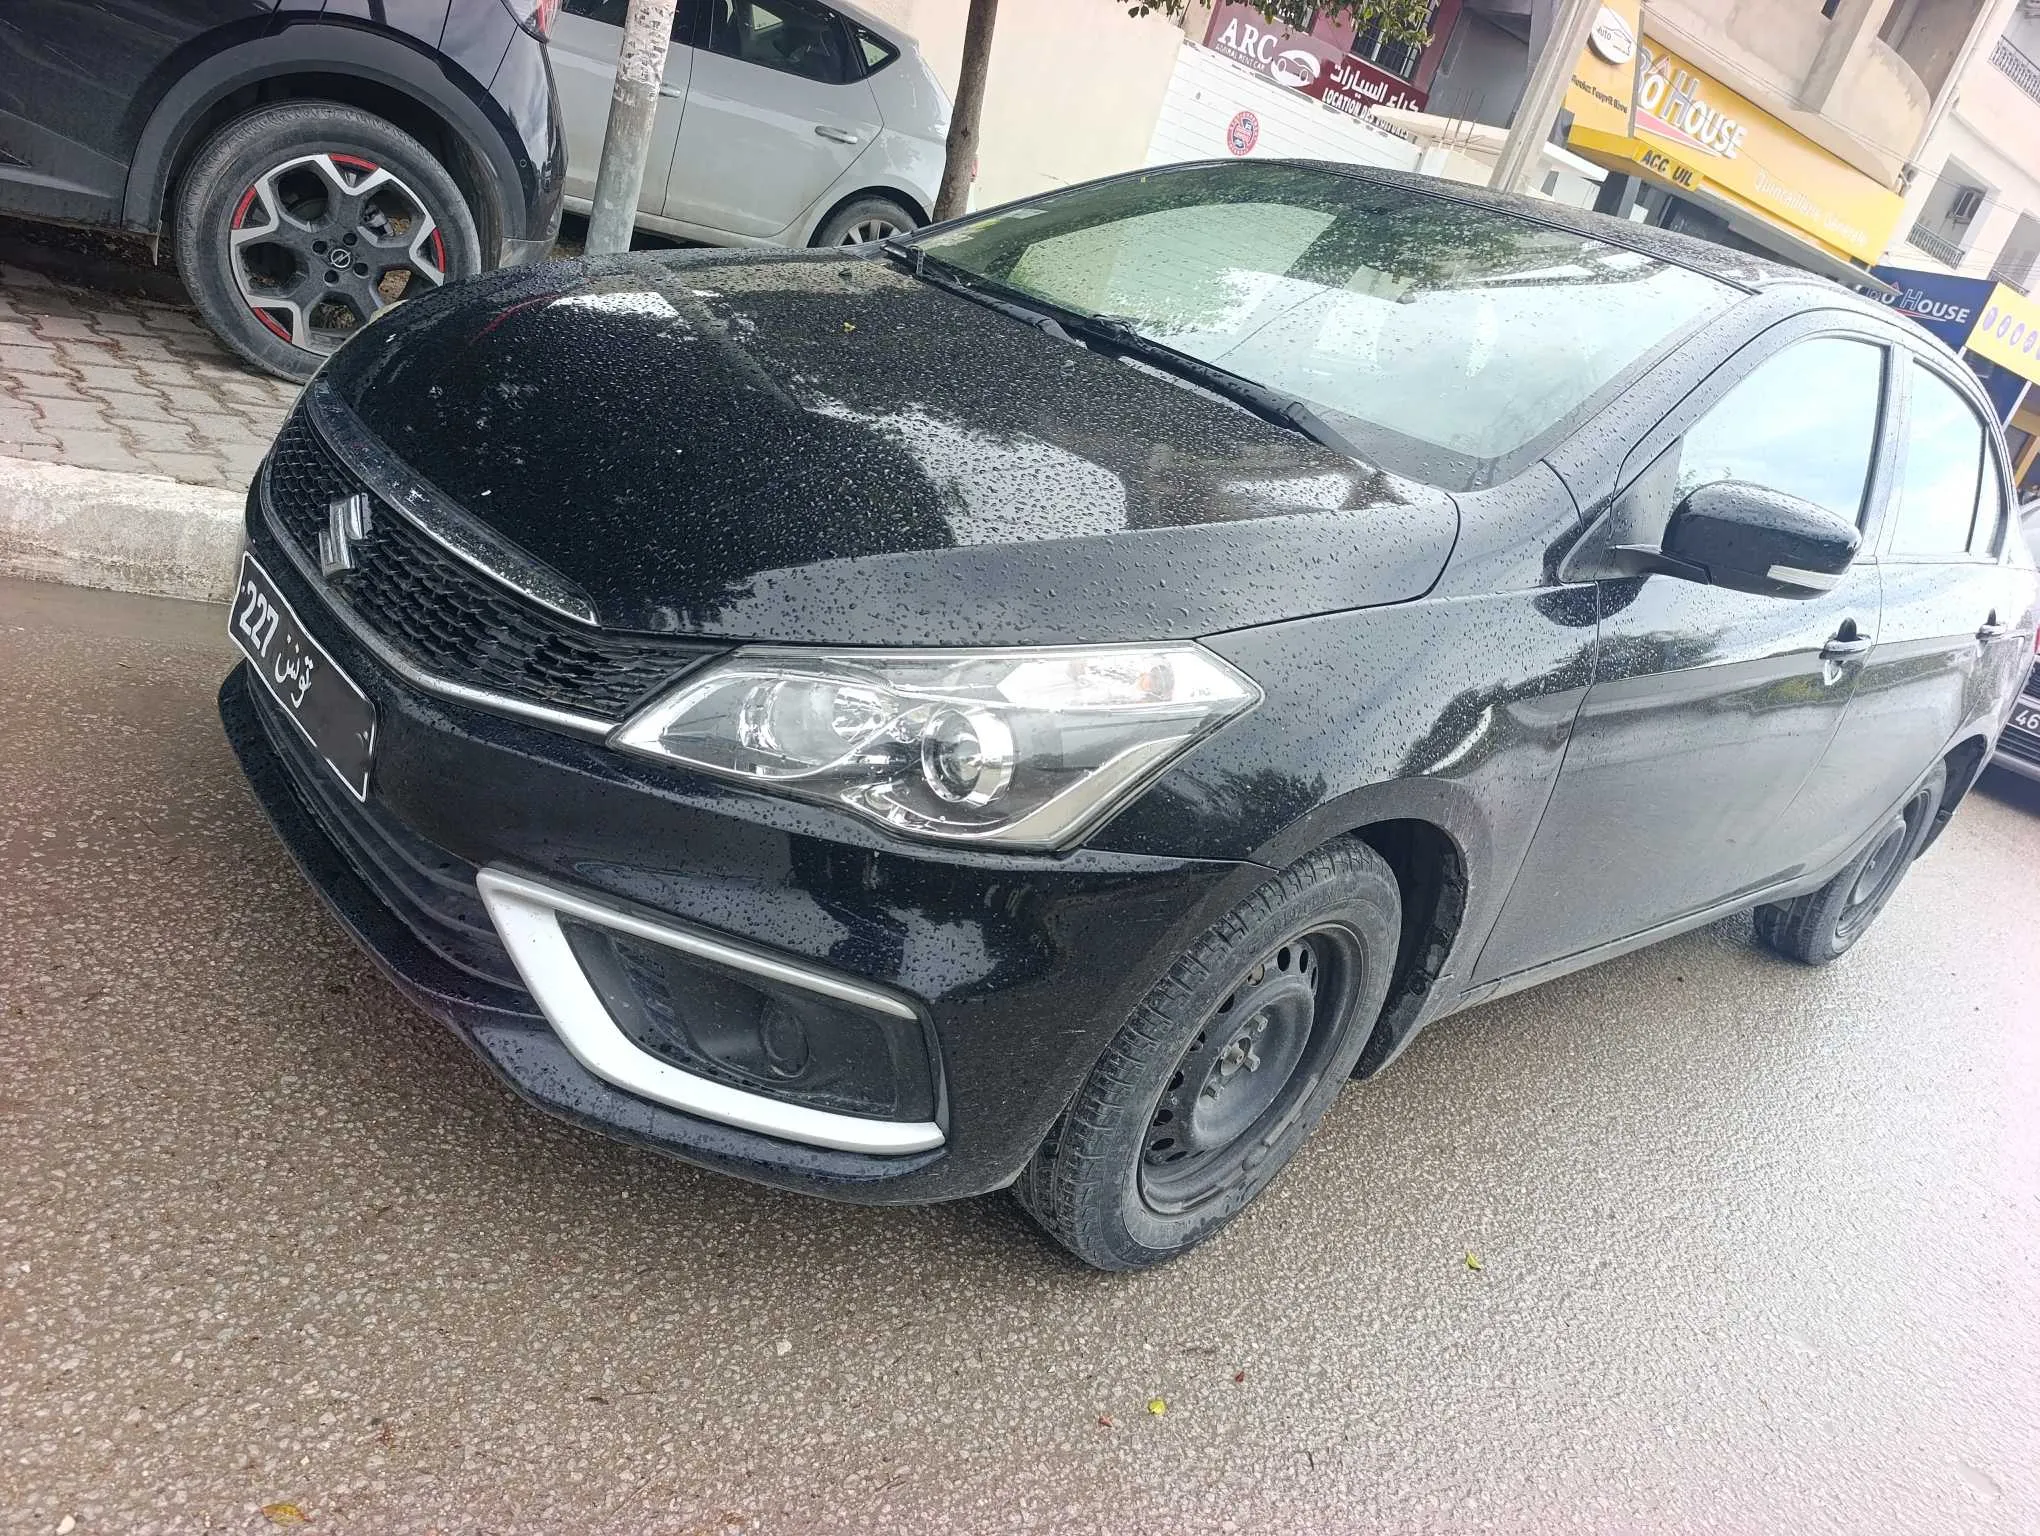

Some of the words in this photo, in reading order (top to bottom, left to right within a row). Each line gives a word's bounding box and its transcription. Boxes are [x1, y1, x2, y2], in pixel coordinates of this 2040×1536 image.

[1217, 17, 1278, 64] ARC
[1329, 65, 1388, 102] السيارات
[1321, 87, 1362, 118] LOCATION
[1661, 69, 1748, 160] HOUSE
[1900, 288, 1970, 324] HOUSE
[239, 580, 279, 658] 227
[274, 633, 314, 709] تونس
[2015, 709, 2040, 729] 46
